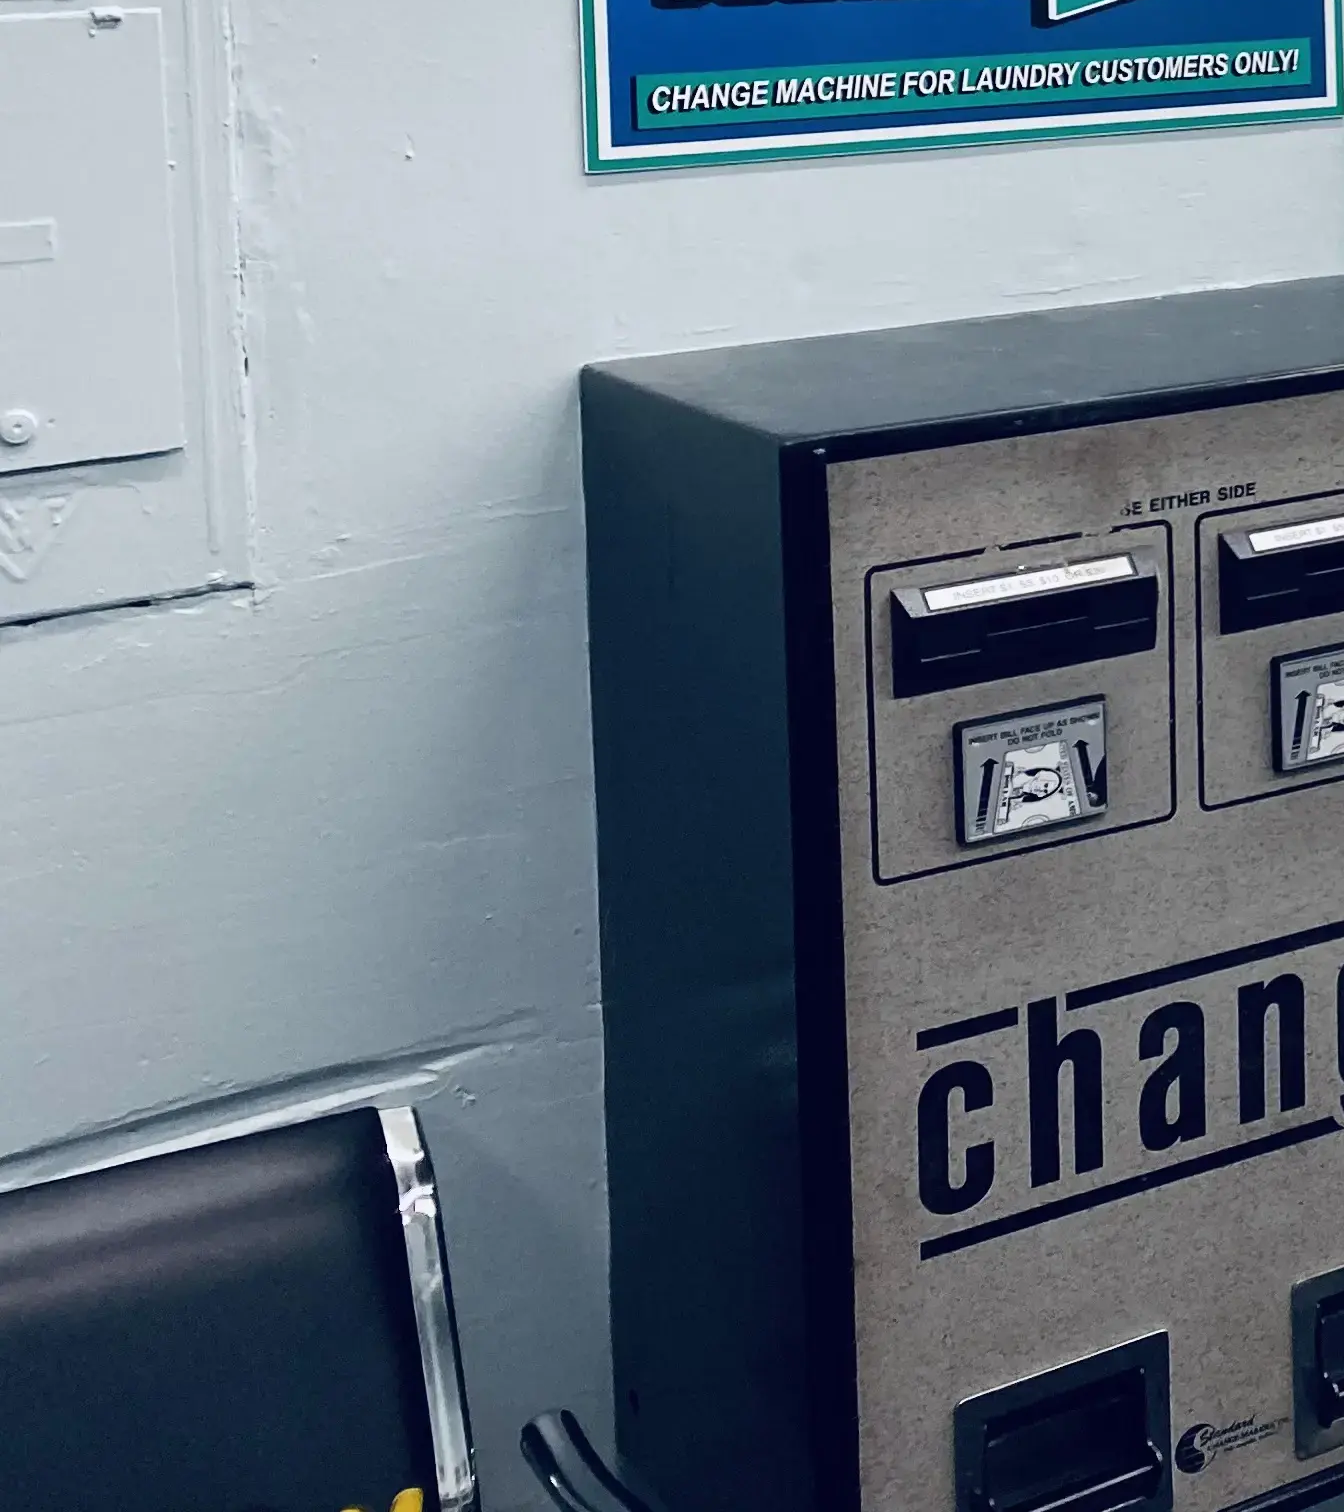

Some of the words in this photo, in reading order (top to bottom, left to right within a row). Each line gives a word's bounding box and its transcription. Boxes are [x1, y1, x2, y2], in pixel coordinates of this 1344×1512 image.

[652, 80, 770, 113] CHANGE
[776, 72, 897, 104] MACHINE
[903, 69, 956, 96] FOR
[961, 61, 1081, 92] LAUNDRY
[1085, 54, 1228, 85] CUSTOMERS
[1234, 48, 1300, 74] ONLY!
[1150, 489, 1210, 513] EITHER
[1217, 482, 1257, 502] SIDE
[1319, 671, 1330, 679] DO
[1332, 667, 1344, 676] NOT
[1000, 729, 1017, 740] BILL
[1020, 725, 1040, 735] FACE
[1042, 721, 1054, 729] UP
[1057, 718, 1067, 727] AS
[1007, 737, 1019, 746] DO
[1022, 732, 1038, 742] NOT
[1040, 728, 1062, 739] FOLD
